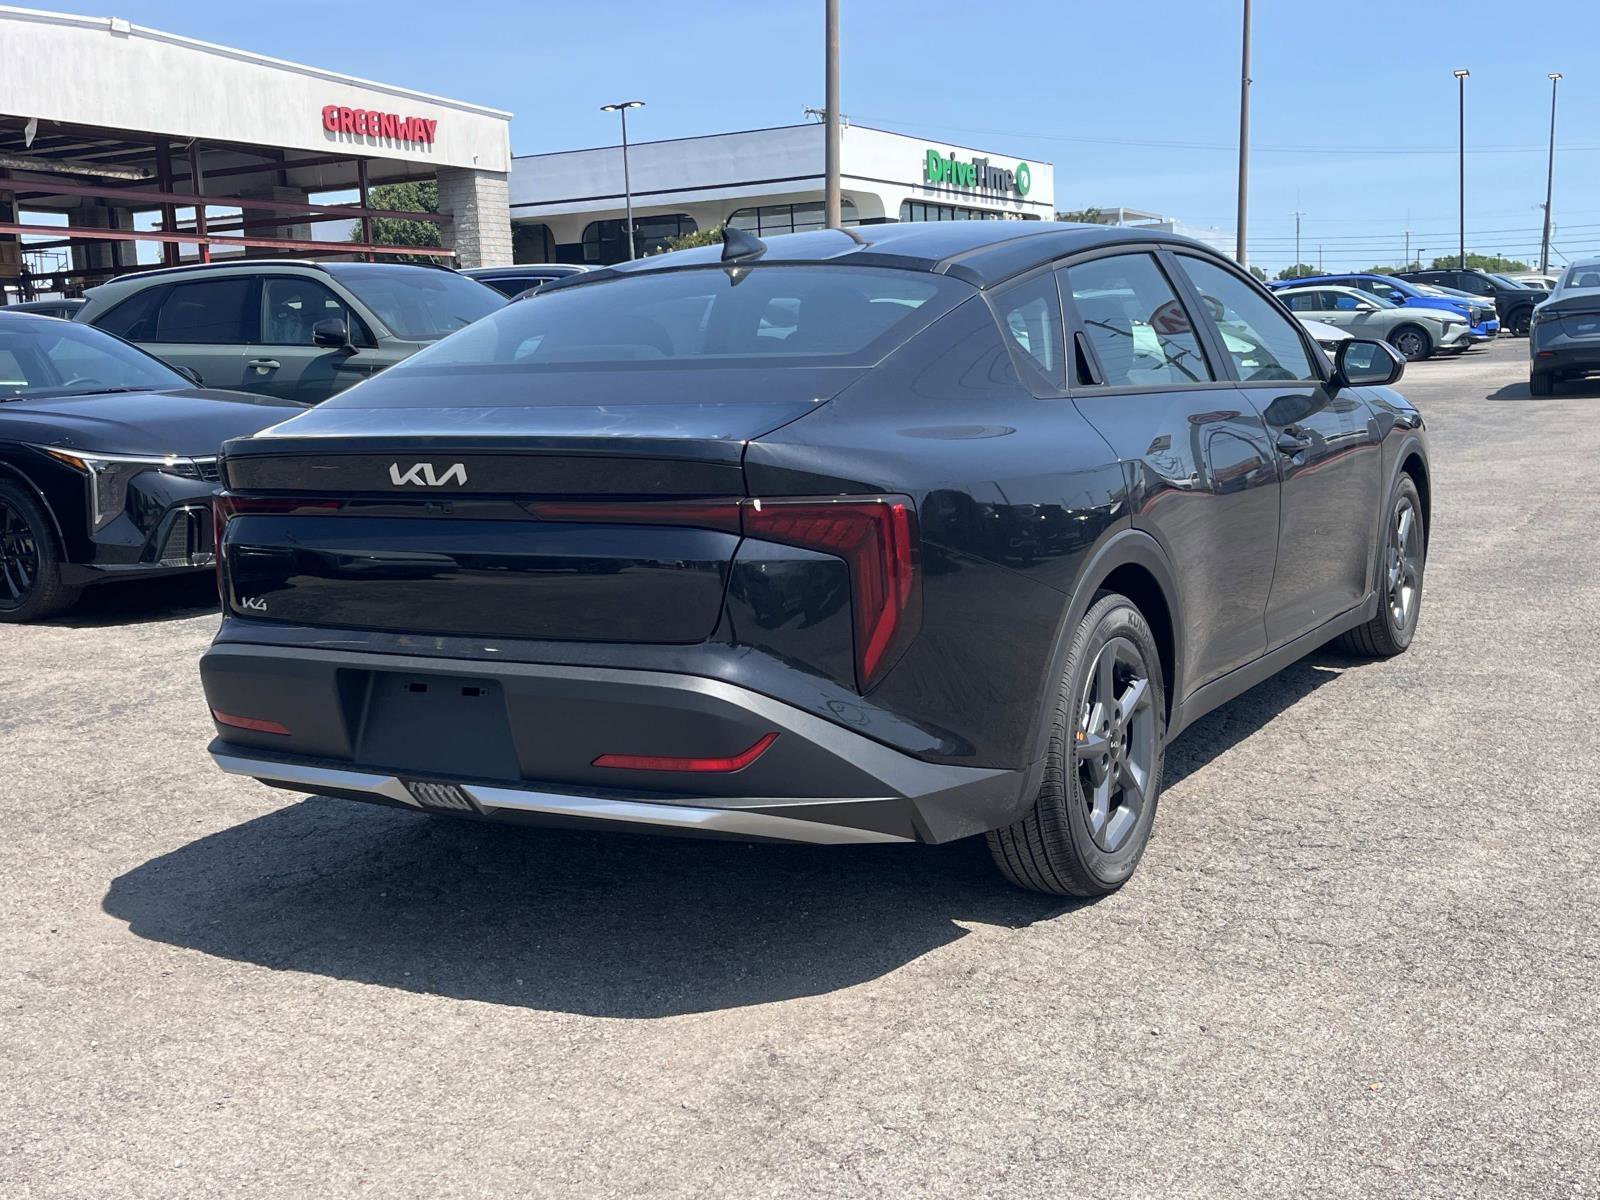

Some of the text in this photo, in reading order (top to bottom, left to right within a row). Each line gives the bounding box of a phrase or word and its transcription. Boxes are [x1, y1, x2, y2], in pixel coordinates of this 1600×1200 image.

[322, 105, 437, 144] GREENWAY
[926, 149, 1014, 191] DriveTime
[389, 462, 468, 486] KIA
[242, 597, 267, 611] K4
